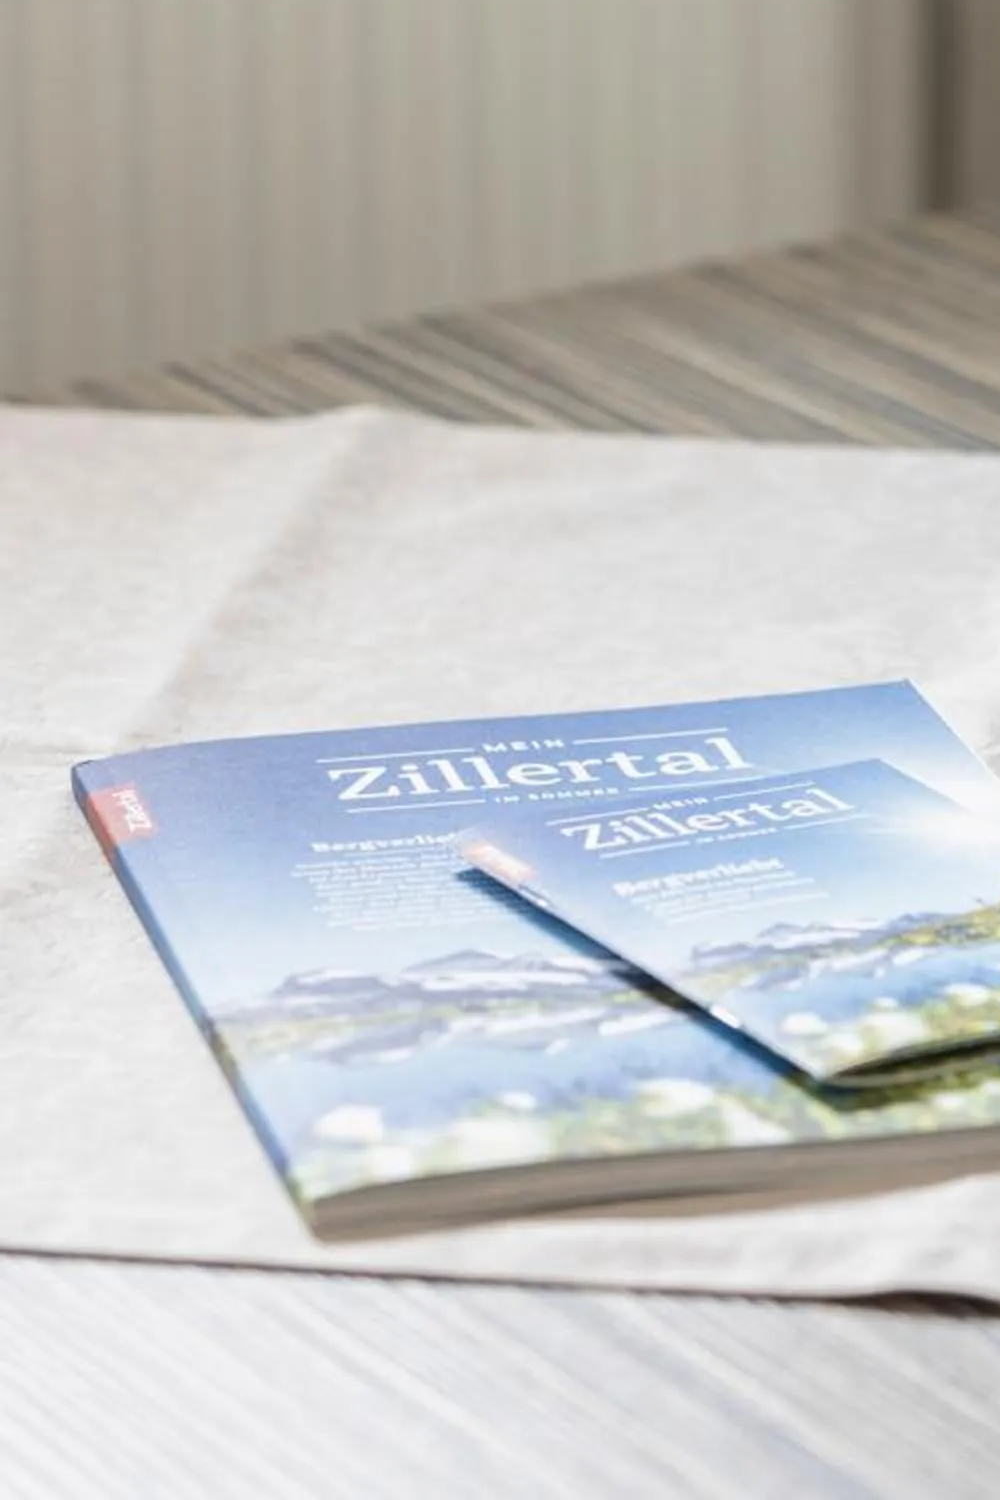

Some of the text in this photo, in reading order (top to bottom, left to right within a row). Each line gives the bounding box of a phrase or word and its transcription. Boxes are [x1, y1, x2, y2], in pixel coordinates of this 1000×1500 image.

[327, 737, 757, 801] Zillertal
[481, 738, 565, 753] MEIN
[560, 788, 857, 851] Zillertal
